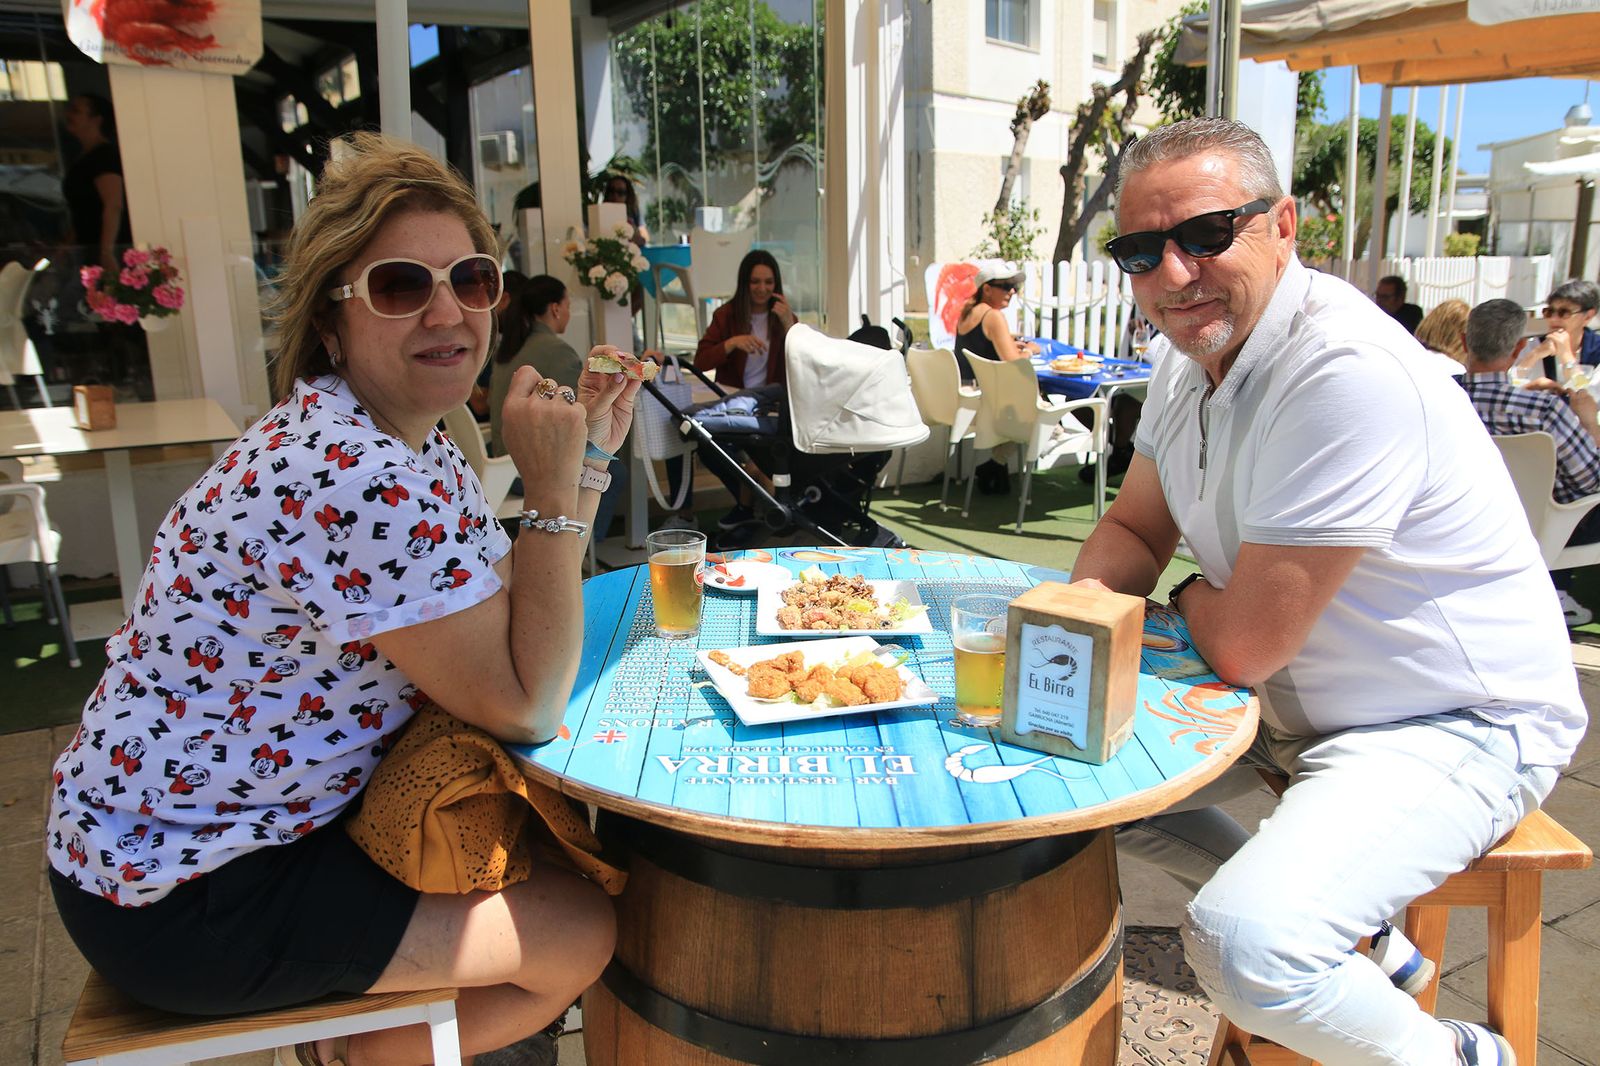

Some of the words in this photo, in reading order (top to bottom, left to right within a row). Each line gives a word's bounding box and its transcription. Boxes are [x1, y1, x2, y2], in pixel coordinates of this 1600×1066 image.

[1032, 635, 1080, 655] RESTAURANTE
[1043, 677, 1075, 698] Birra
[597, 718, 713, 728] RATIONS
[777, 745, 870, 753] GARRUCHA
[655, 755, 831, 776] BIRRA
[844, 755, 918, 776] EL
[684, 776, 837, 785] RESTAURANTE
[855, 776, 898, 785] BAR
